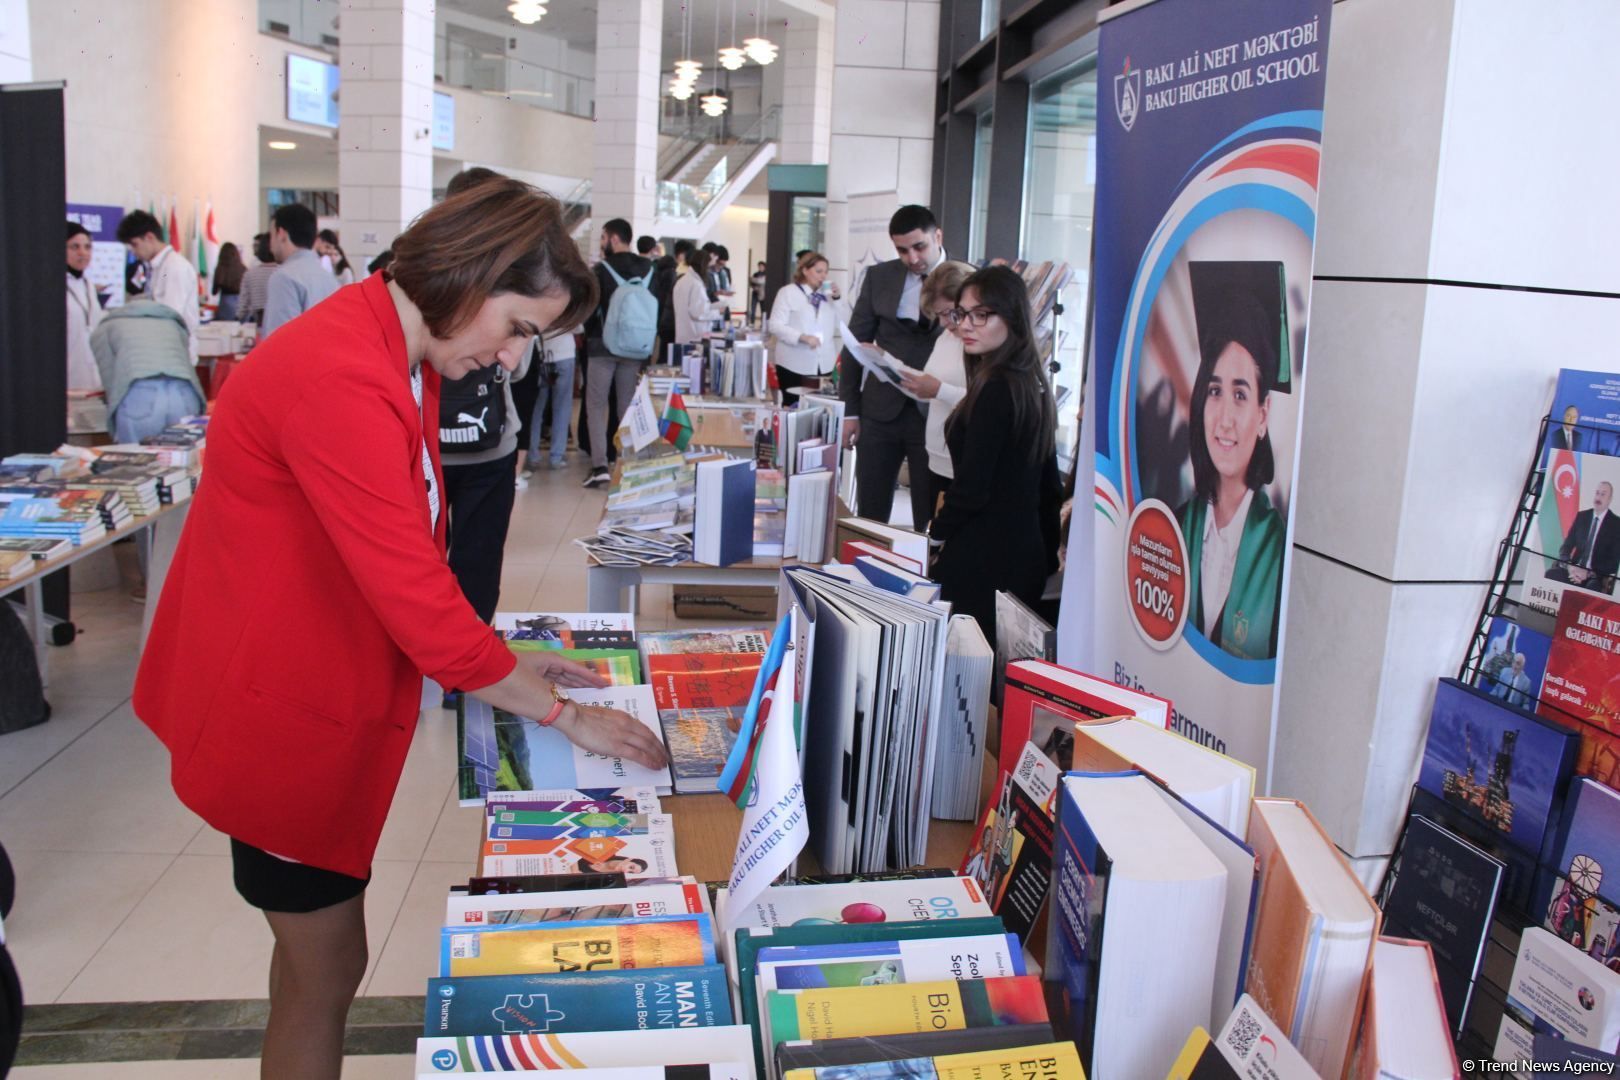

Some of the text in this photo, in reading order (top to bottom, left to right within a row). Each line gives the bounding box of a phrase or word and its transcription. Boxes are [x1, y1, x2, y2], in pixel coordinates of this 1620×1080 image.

[1145, 15, 1319, 87] BAKI ALİ NEFT MƏKTƏBİ
[1145, 52, 1320, 112] BAKU HIGHER OIL SCHOOL
[439, 426, 479, 443] UMA
[1135, 577, 1174, 622] 100%
[1577, 611, 1603, 631] BAKI
[1114, 661, 1131, 687] Biz
[750, 807, 779, 838] NEFT
[743, 829, 785, 871] HIGHER
[783, 811, 801, 831] OIL
[929, 896, 959, 918] OR
[634, 983, 648, 1008] David
[654, 982, 672, 1005] AN
[674, 981, 699, 1027] MAN
[700, 979, 713, 1009] Seventh
[440, 999, 452, 1030] Pearson
[806, 1002, 817, 1027] Nigel
[822, 1001, 832, 1025] David
[927, 993, 951, 1030] Bio
[1039, 1058, 1057, 1080] BI
